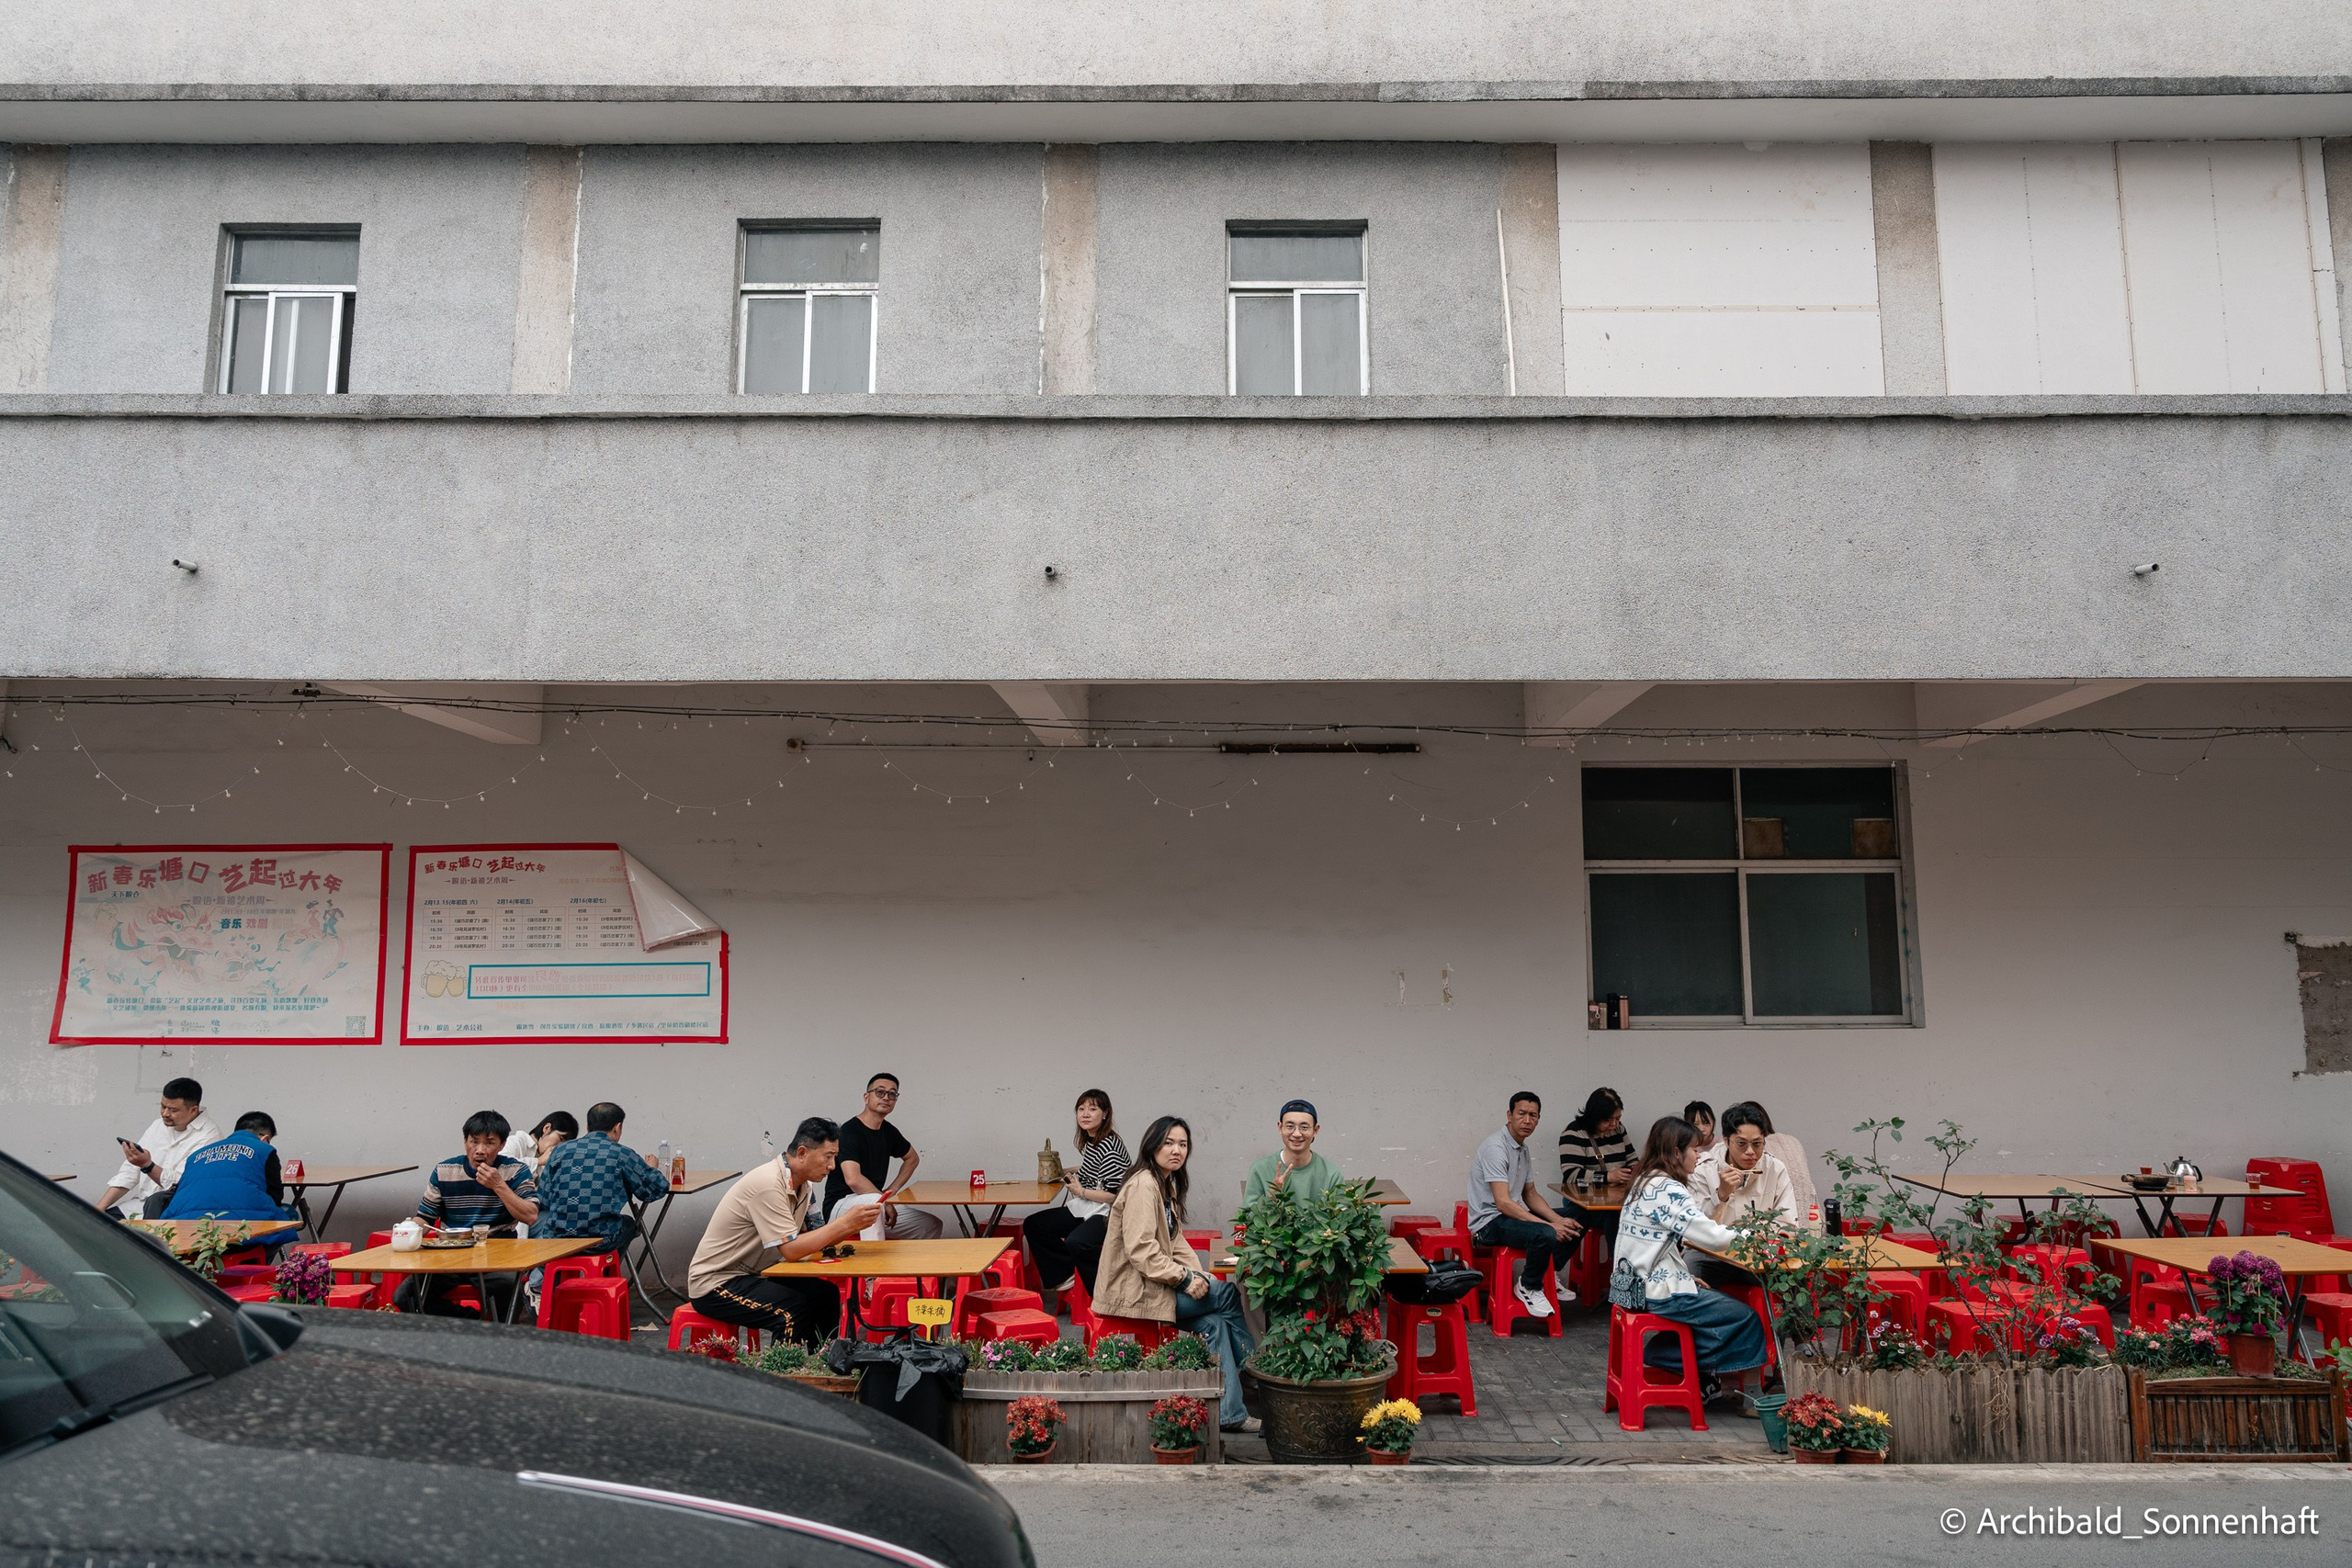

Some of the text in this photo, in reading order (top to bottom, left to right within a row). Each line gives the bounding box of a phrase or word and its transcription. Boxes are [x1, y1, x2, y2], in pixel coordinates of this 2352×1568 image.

[220, 919, 243, 930] 音乐
[194, 1144, 254, 1164] DIAMOND
[205, 1151, 239, 1164] LIFE
[285, 1163, 299, 1175] 26
[973, 1174, 985, 1185] 25
